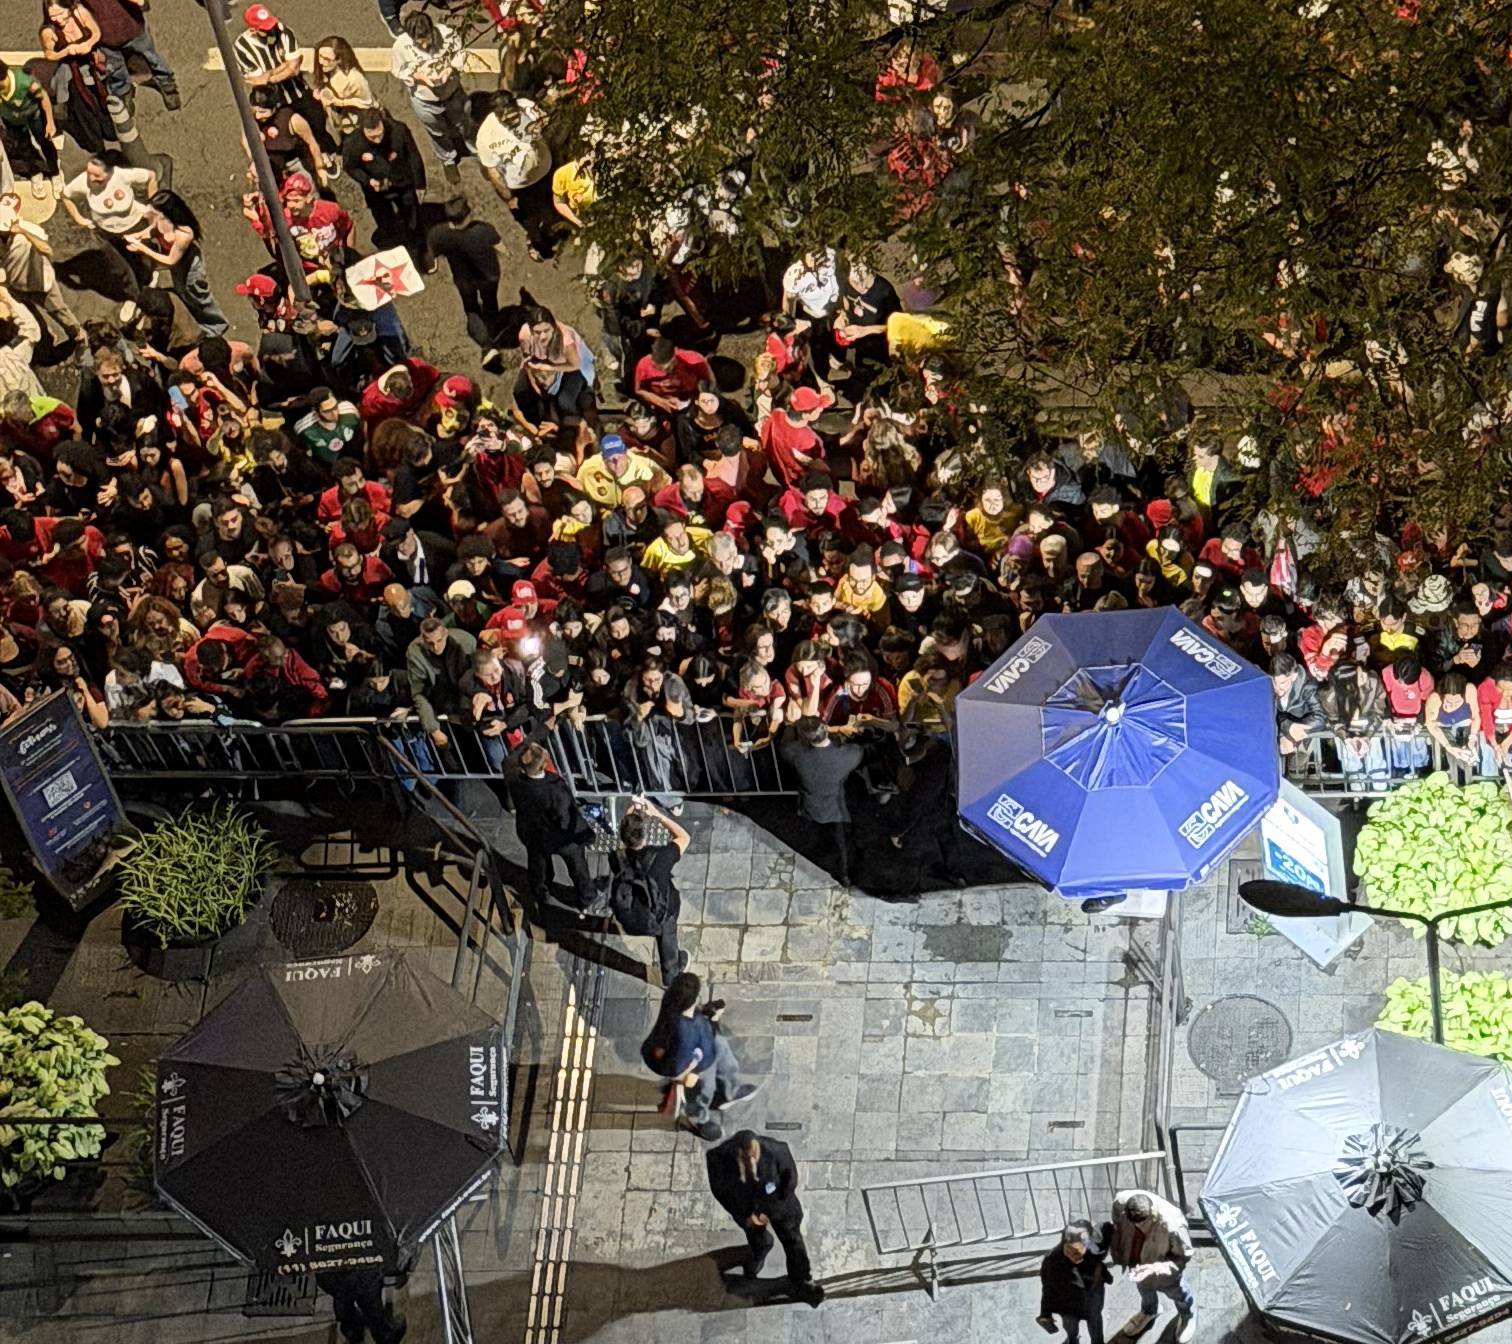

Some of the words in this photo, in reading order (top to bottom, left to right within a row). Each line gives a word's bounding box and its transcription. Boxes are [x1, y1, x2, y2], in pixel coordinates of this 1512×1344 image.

[1170, 629, 1215, 663] CAVA
[987, 658, 1030, 694] CAVA
[1201, 780, 1245, 824] CAVA
[1014, 812, 1060, 853] CAVA
[284, 967, 341, 983] FAQUI
[469, 1046, 487, 1096] FAQUI
[170, 1105, 186, 1156] FAQUI
[315, 1220, 372, 1241] FAQUI
[1240, 1229, 1280, 1283] FAQUI
[1438, 1277, 1495, 1312] FAQUI
